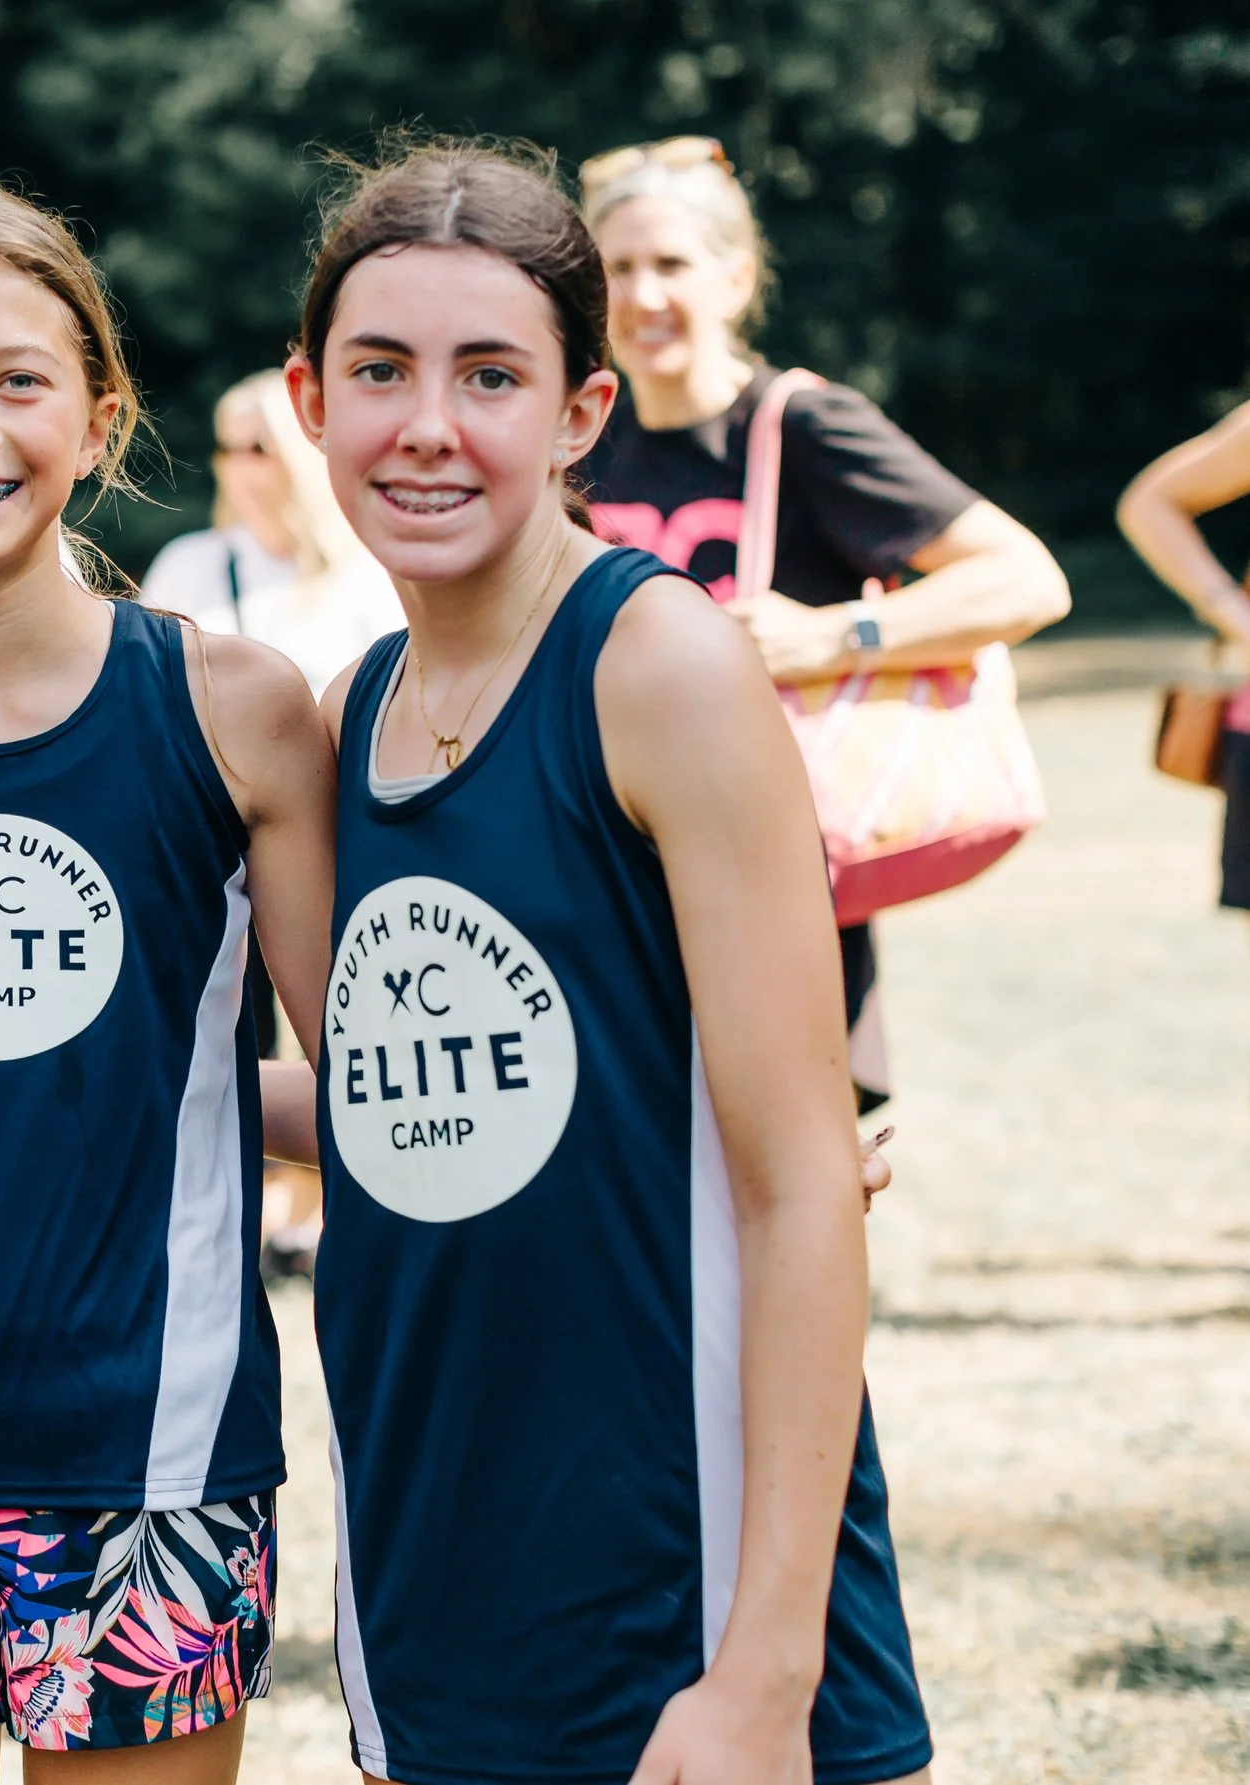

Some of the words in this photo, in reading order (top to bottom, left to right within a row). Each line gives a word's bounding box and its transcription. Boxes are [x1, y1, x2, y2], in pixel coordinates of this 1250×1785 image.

[332, 912, 391, 1036] YOUTH
[409, 902, 552, 1021] RUNNER
[346, 1031, 530, 1105] ELITE
[391, 1117, 475, 1151] CAMP
